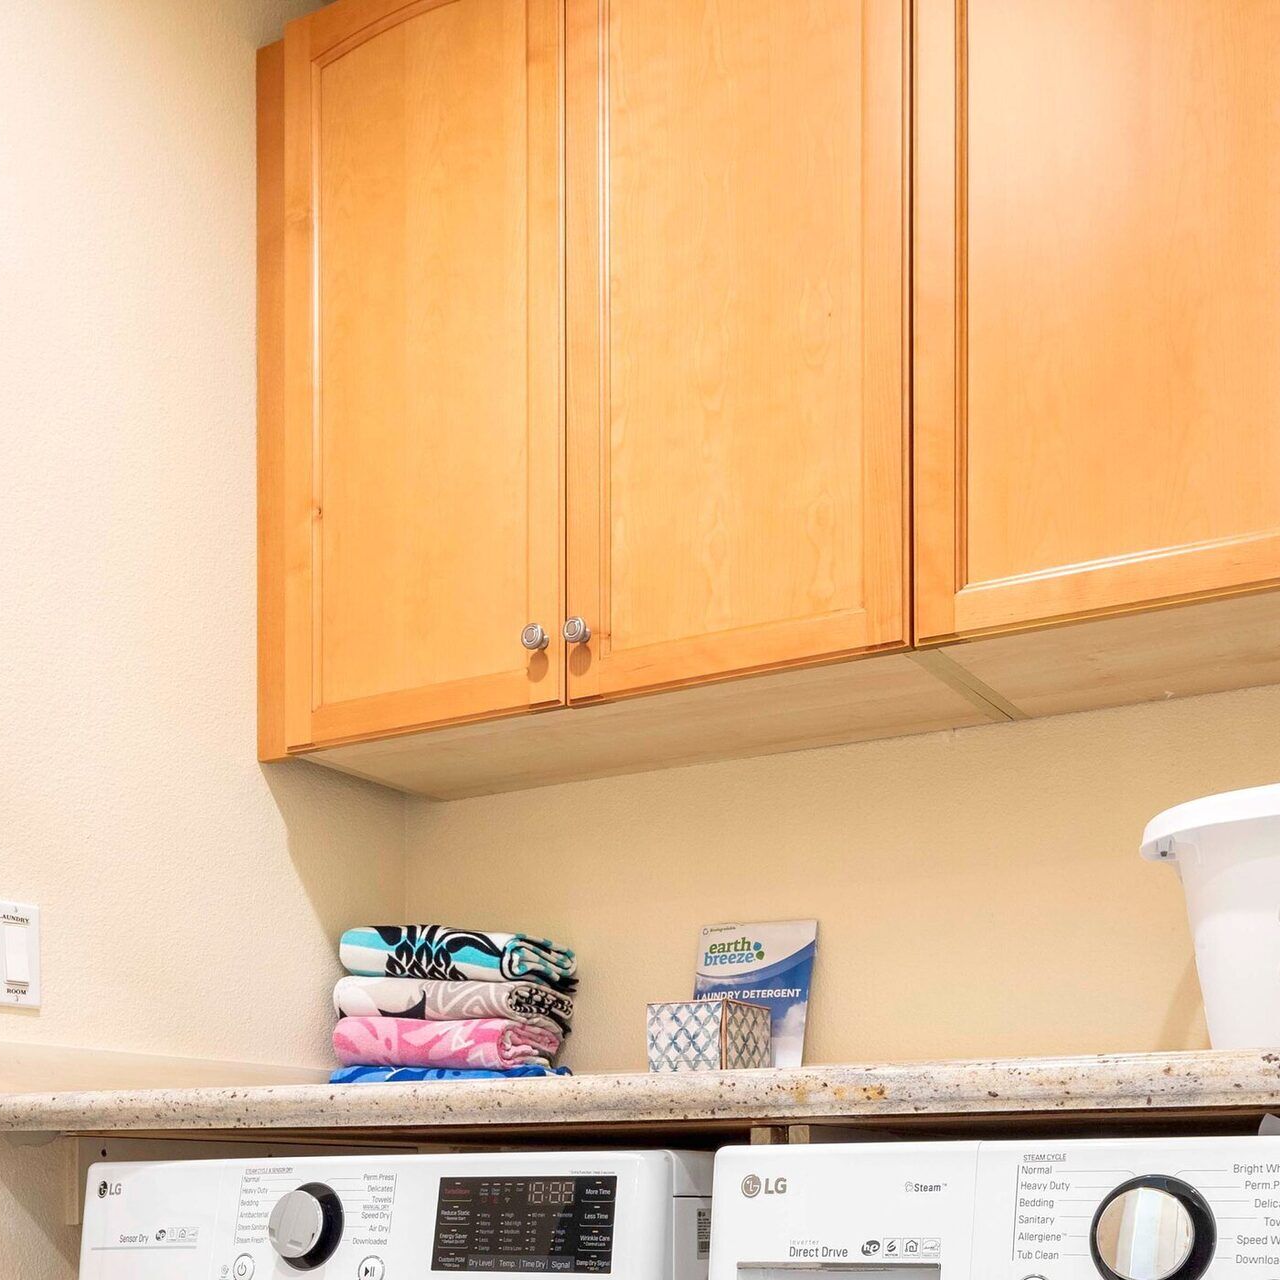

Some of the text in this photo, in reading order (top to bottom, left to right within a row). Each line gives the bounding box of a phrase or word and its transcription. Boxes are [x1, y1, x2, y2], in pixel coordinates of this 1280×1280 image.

[709, 937, 752, 954] earth
[704, 952, 754, 966] breeze
[697, 989, 802, 1000] LAUNDRY DETERGENT
[1022, 1165, 1052, 1174] Normal
[1233, 1164, 1263, 1175] Bright
[109, 1183, 122, 1195] LG
[764, 1178, 787, 1194] LG
[1020, 1181, 1070, 1191] Heavy Duty
[1020, 1198, 1054, 1208] Bedding
[380, 1212, 390, 1220] Dry
[1019, 1215, 1055, 1226] Sanitary
[120, 1234, 138, 1243] Sensor
[139, 1234, 149, 1244] Dry
[1236, 1235, 1268, 1246] Speed
[790, 1247, 848, 1258] Direct Drive
[1017, 1250, 1059, 1260] Tub Clean
[552, 1261, 570, 1269] Signal
